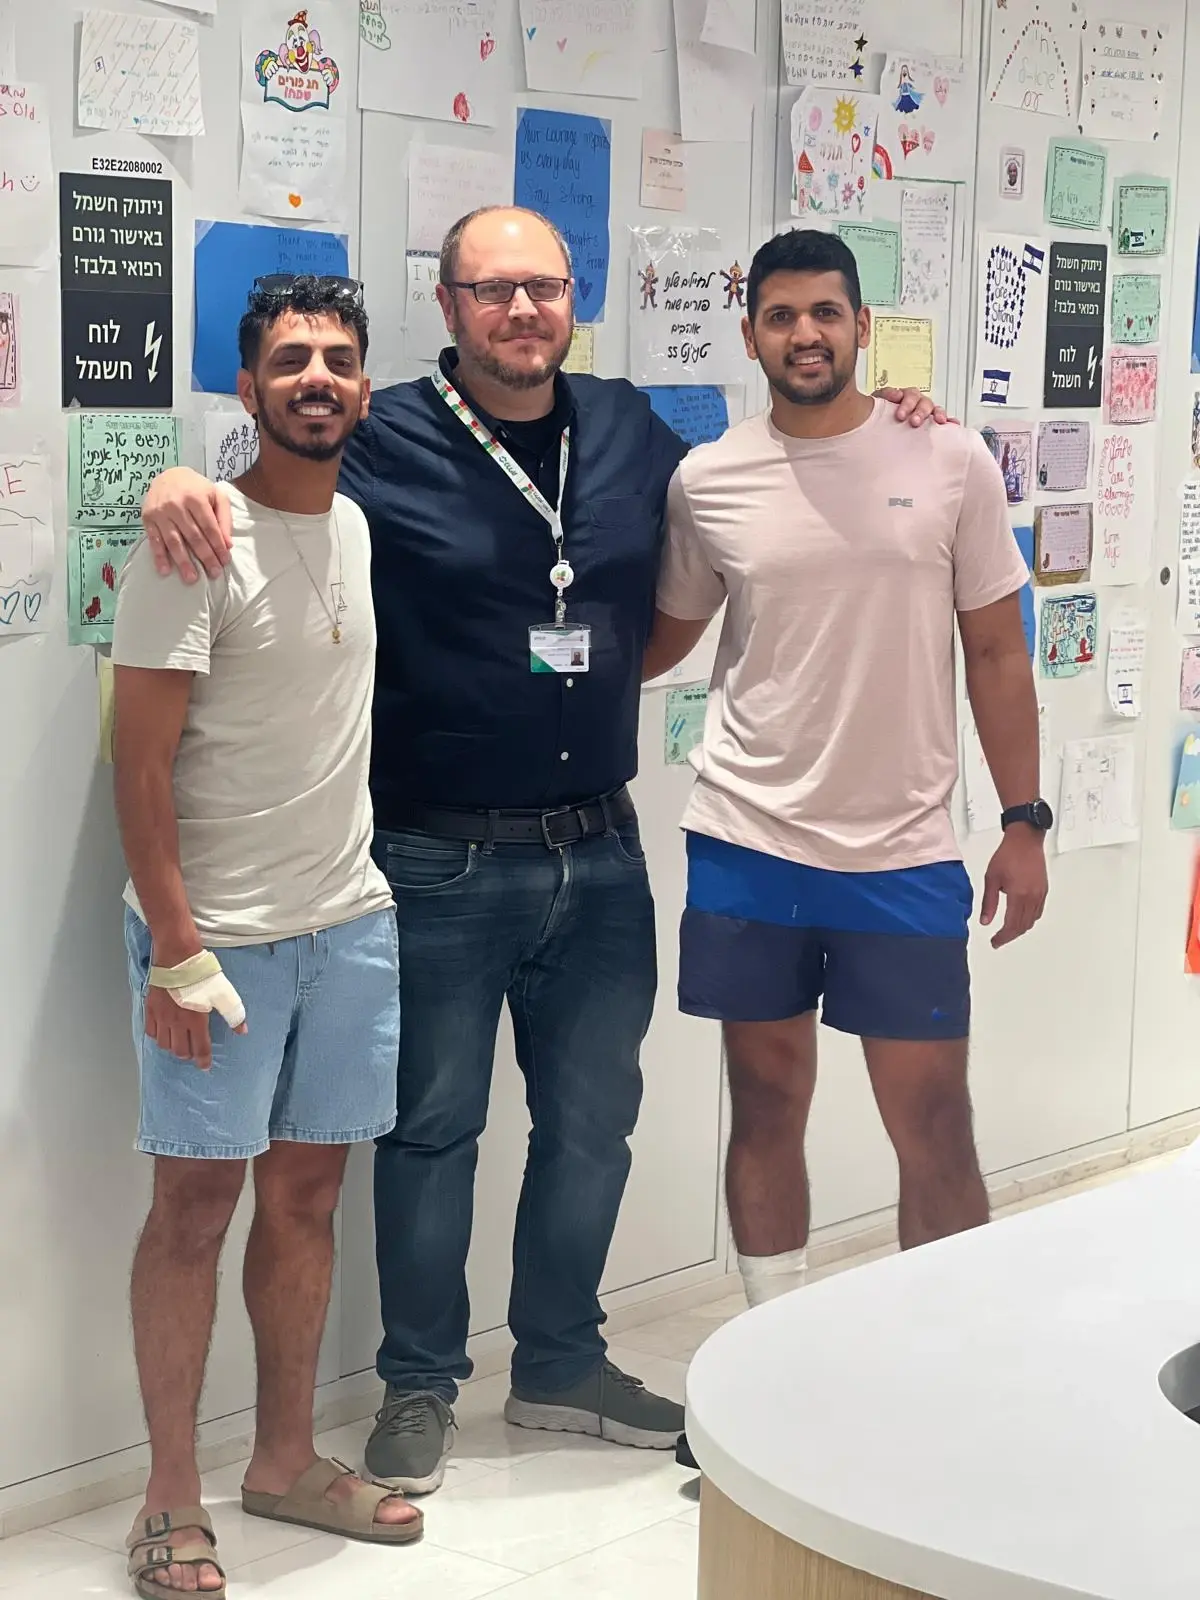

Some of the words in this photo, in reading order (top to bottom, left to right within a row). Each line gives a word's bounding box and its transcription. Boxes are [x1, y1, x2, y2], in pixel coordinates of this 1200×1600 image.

[278, 75, 305, 88] פורים
[306, 79, 319, 90] חג
[92, 157, 163, 174] E32E22080002
[72, 190, 118, 213] חשמל
[123, 197, 163, 218] ניתוק
[72, 226, 105, 243] גורם
[110, 228, 163, 247] באישור
[74, 255, 118, 275] בלבד!
[121, 260, 162, 277] רפואי
[1056, 254, 1080, 270] חשמל
[1081, 259, 1103, 273] ניתוק
[1054, 279, 1072, 291] גורם
[1073, 281, 1101, 293] באישור
[664, 298, 682, 311] שמח
[683, 299, 711, 312] פורים
[1053, 299, 1077, 314] בלבד!
[1078, 303, 1099, 315] רפואי
[88, 319, 121, 344] לוח
[671, 322, 702, 335] אוהבים
[1059, 345, 1077, 363] לוח
[75, 355, 133, 380] חשמל
[1052, 370, 1082, 388] חשמל
[104, 431, 127, 449] טוב
